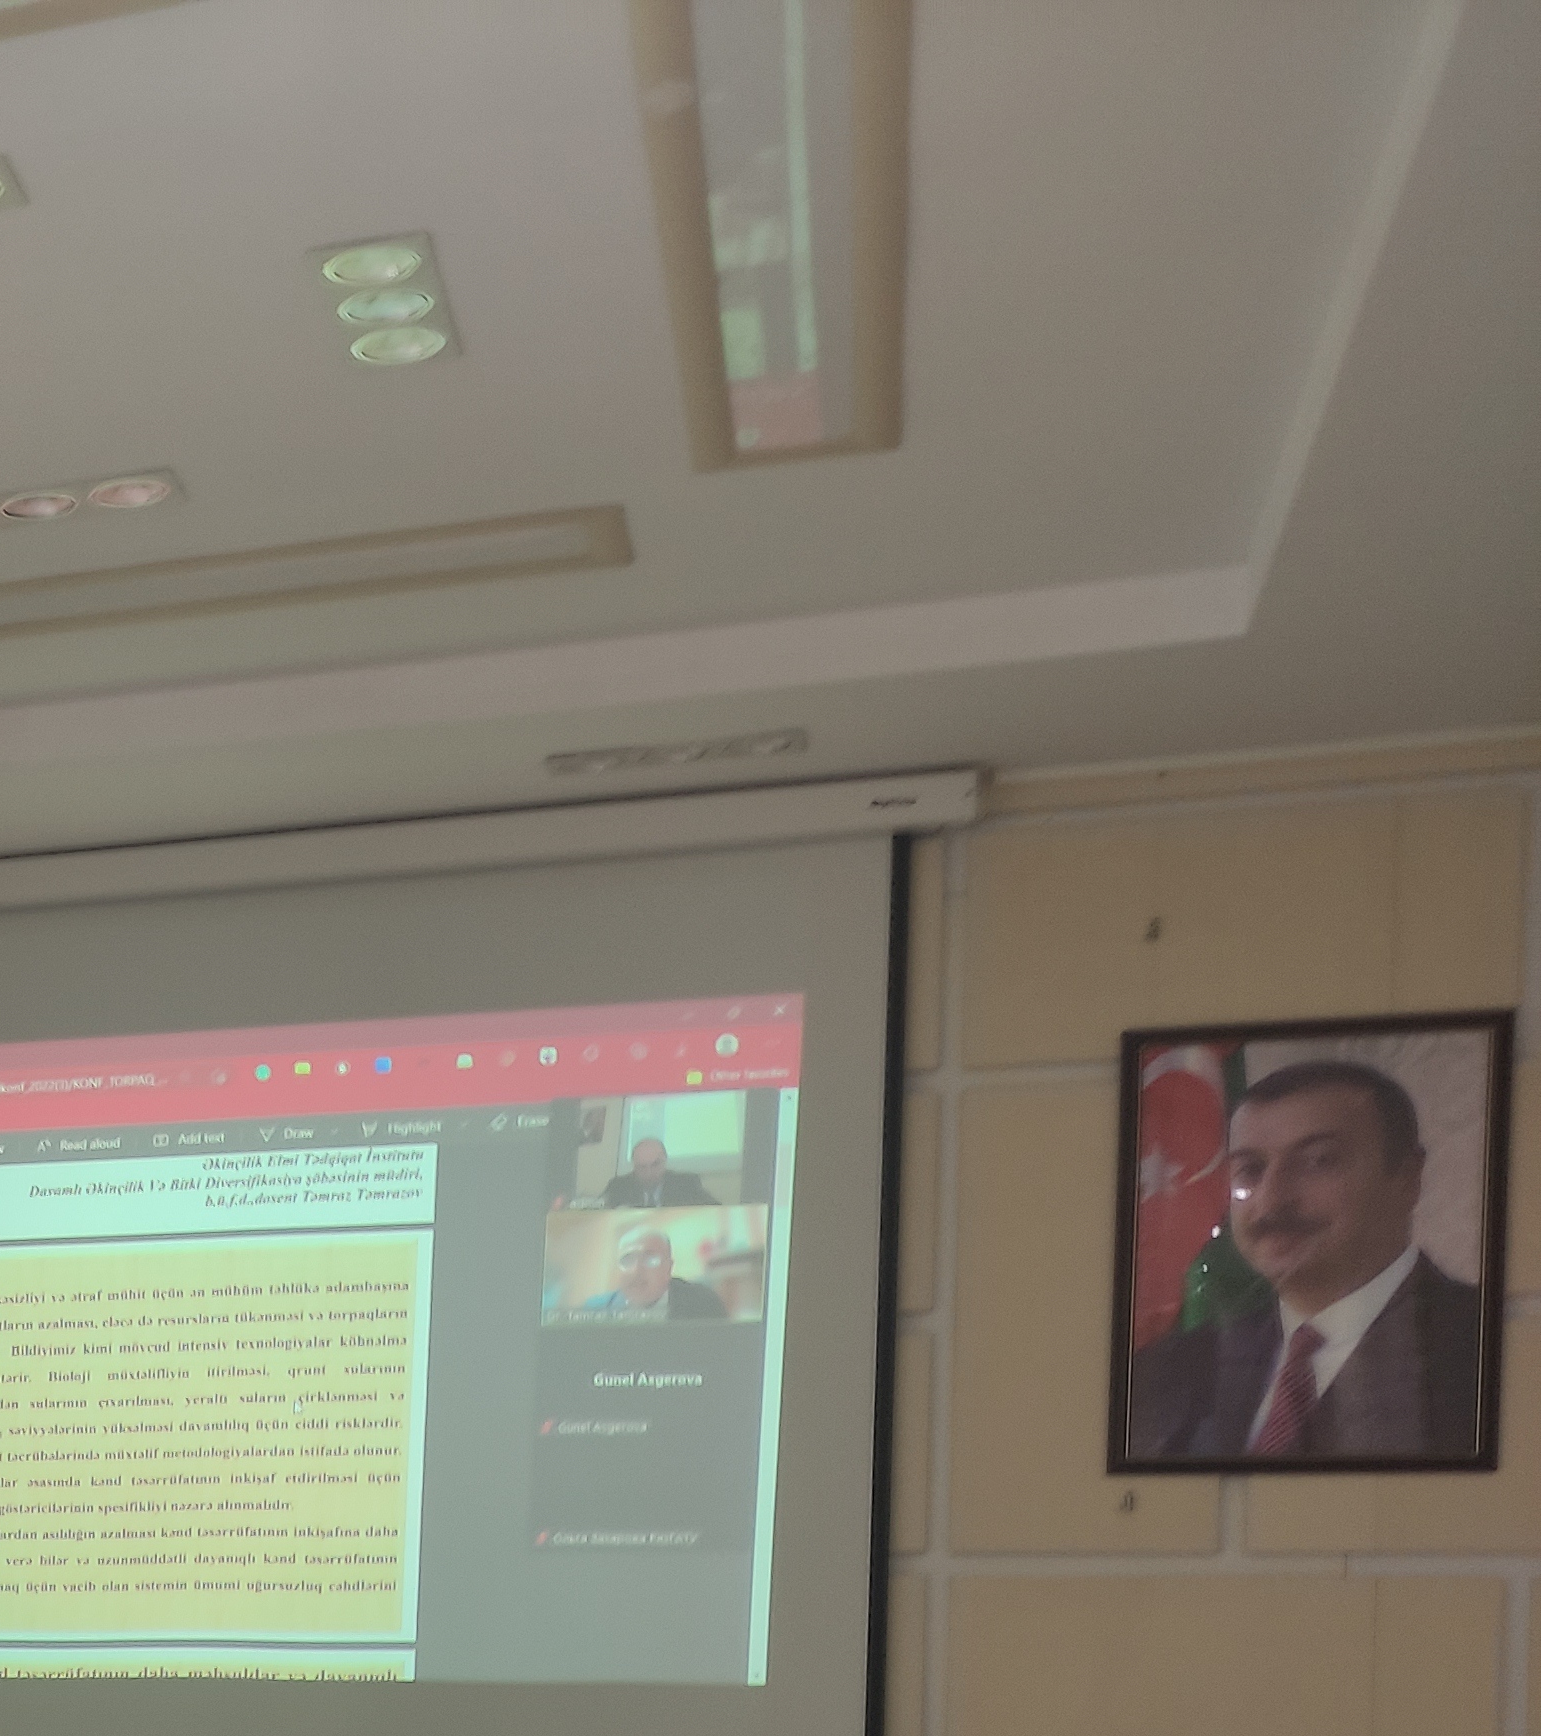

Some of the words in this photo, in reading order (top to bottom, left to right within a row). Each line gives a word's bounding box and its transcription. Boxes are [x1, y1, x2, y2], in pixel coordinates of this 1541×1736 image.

[283, 1127, 314, 1140] Draw
[387, 1121, 442, 1135] Highlight
[59, 1138, 86, 1151] Read
[88, 1137, 121, 1150] aloud
[178, 1132, 200, 1145] Add
[202, 1132, 225, 1144] text
[593, 1373, 634, 1388] Gunel
[637, 1372, 703, 1389] Asgerova
